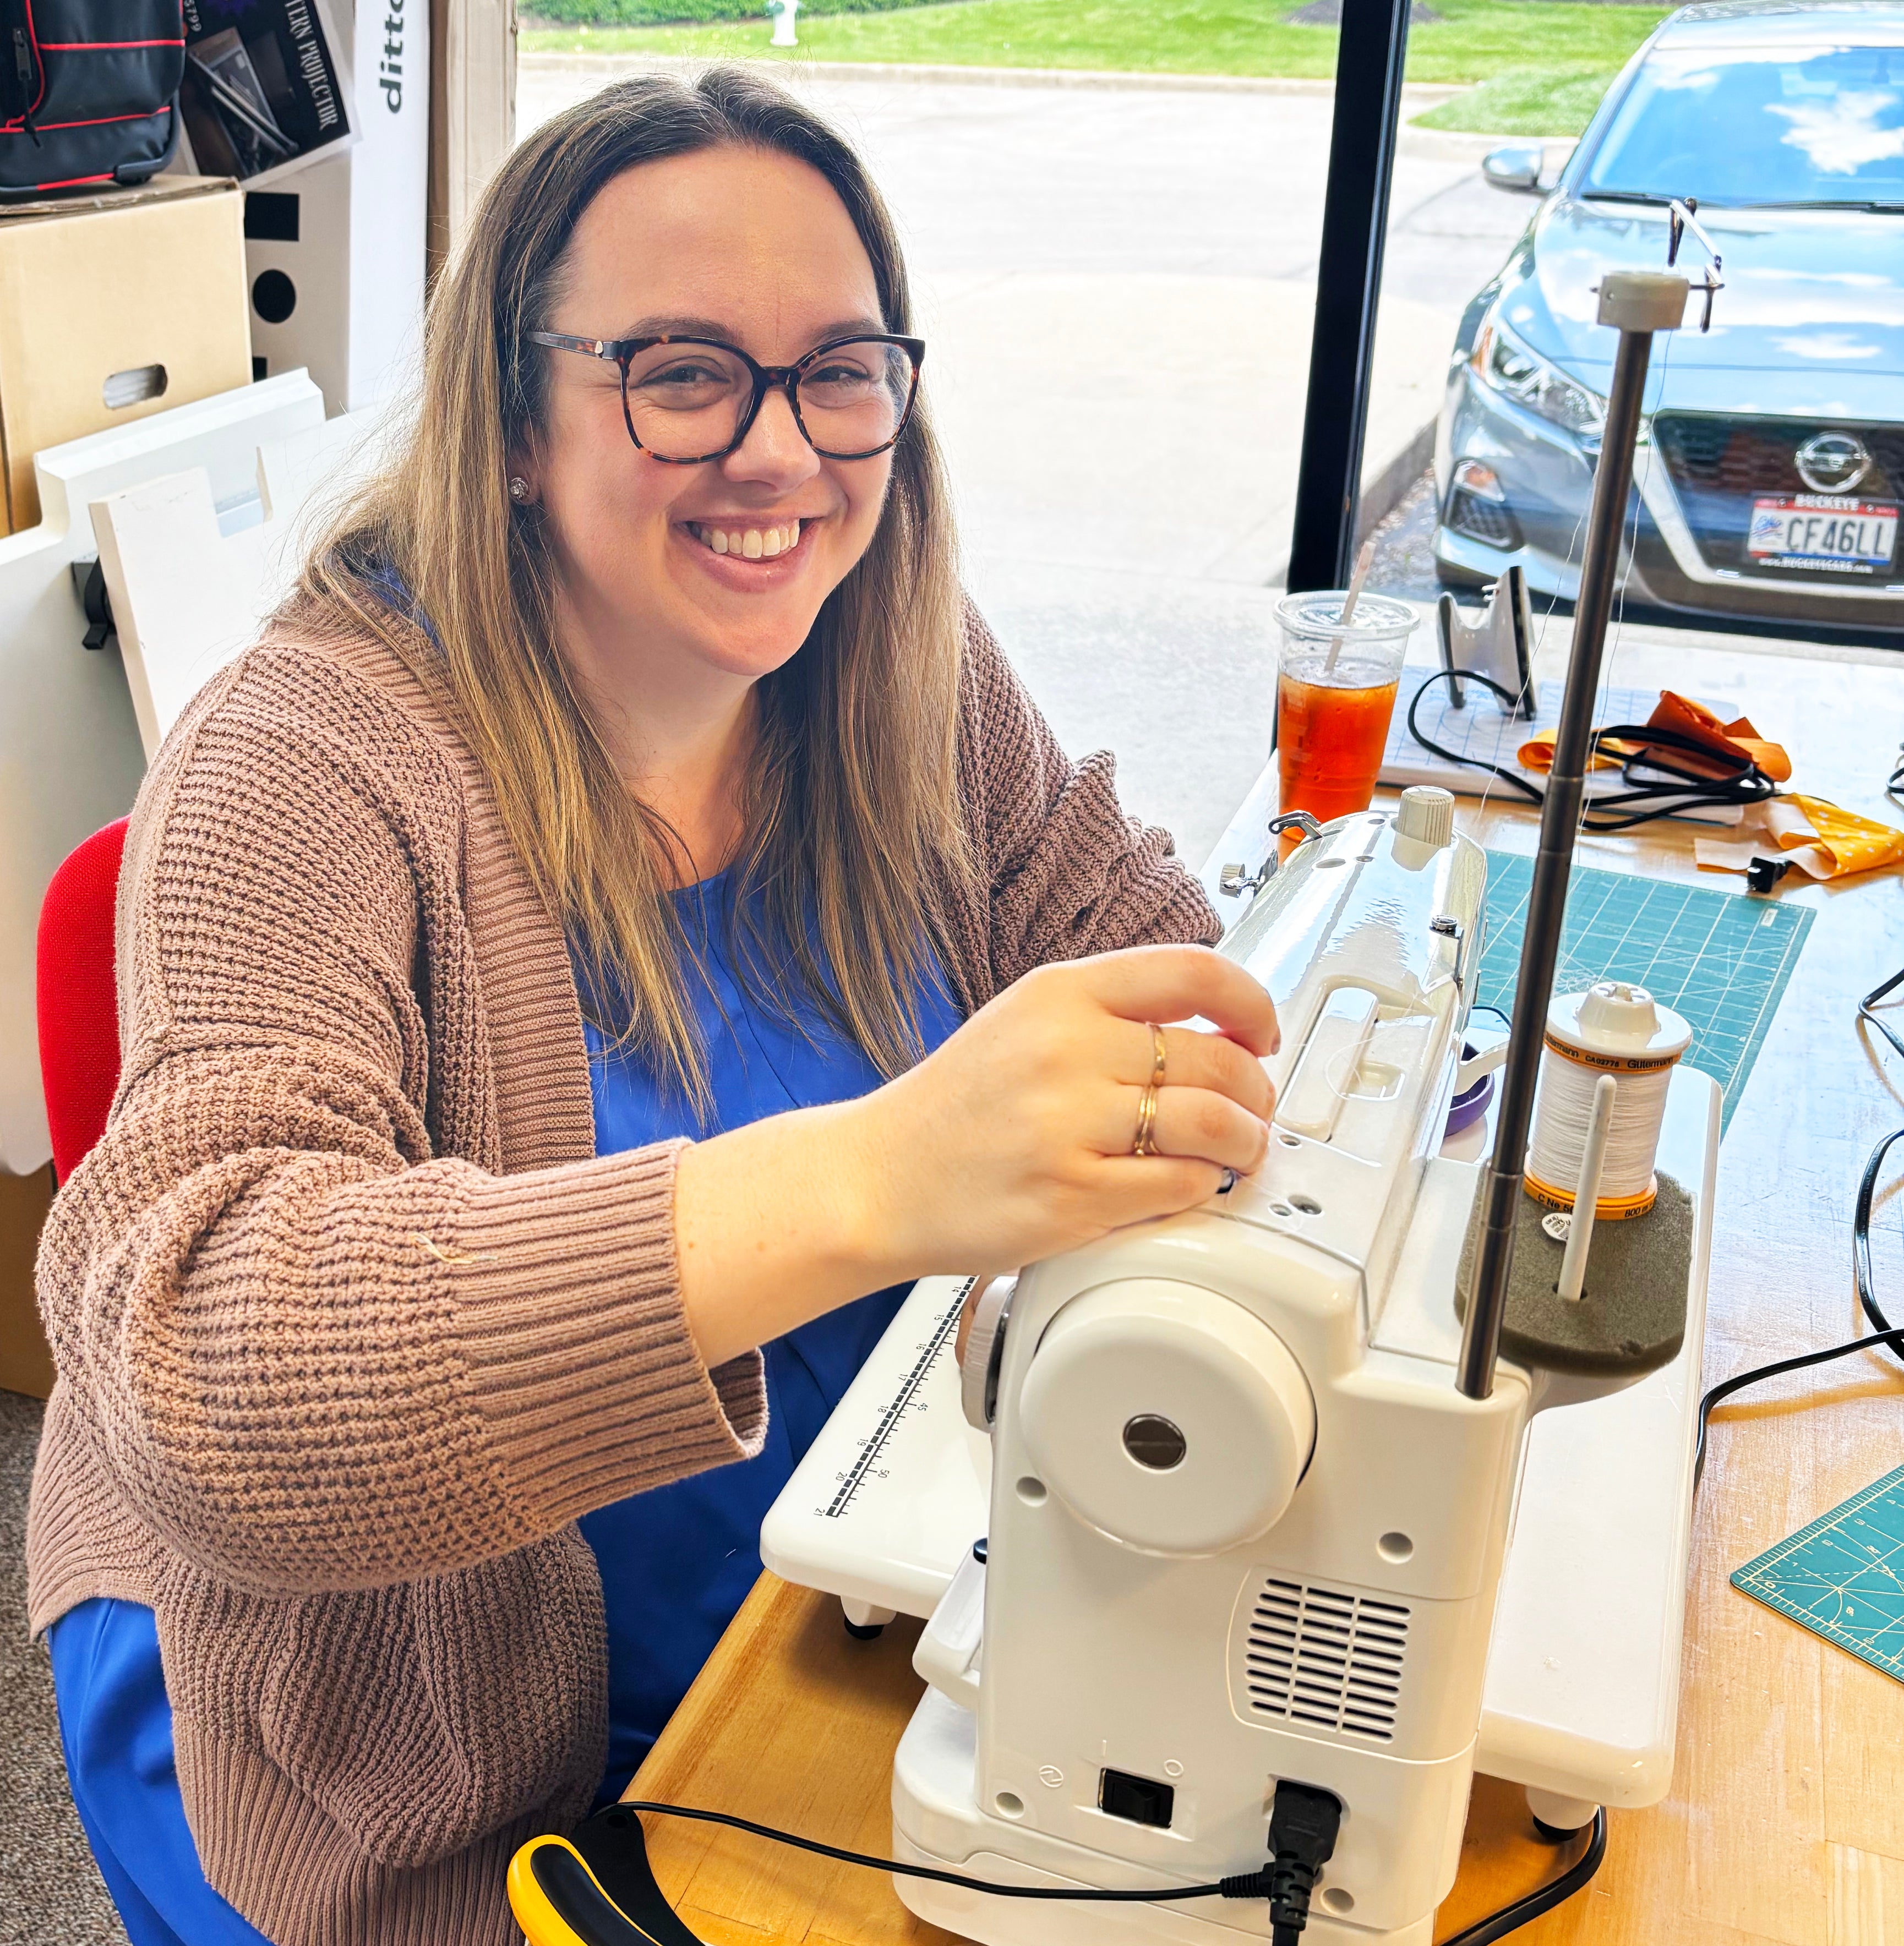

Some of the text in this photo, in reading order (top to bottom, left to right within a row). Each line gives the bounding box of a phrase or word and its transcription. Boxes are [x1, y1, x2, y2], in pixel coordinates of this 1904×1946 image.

[298, 40, 339, 130] PROJECTOR
[1787, 517, 1887, 556] CF46LL
[1538, 1194, 1545, 1202] C
[1625, 1207, 1641, 1217] 800
[918, 1403, 928, 1411] 45
[836, 1472, 847, 1481] 20
[878, 1469, 890, 1478] 50
[814, 1508, 825, 1516] 21
